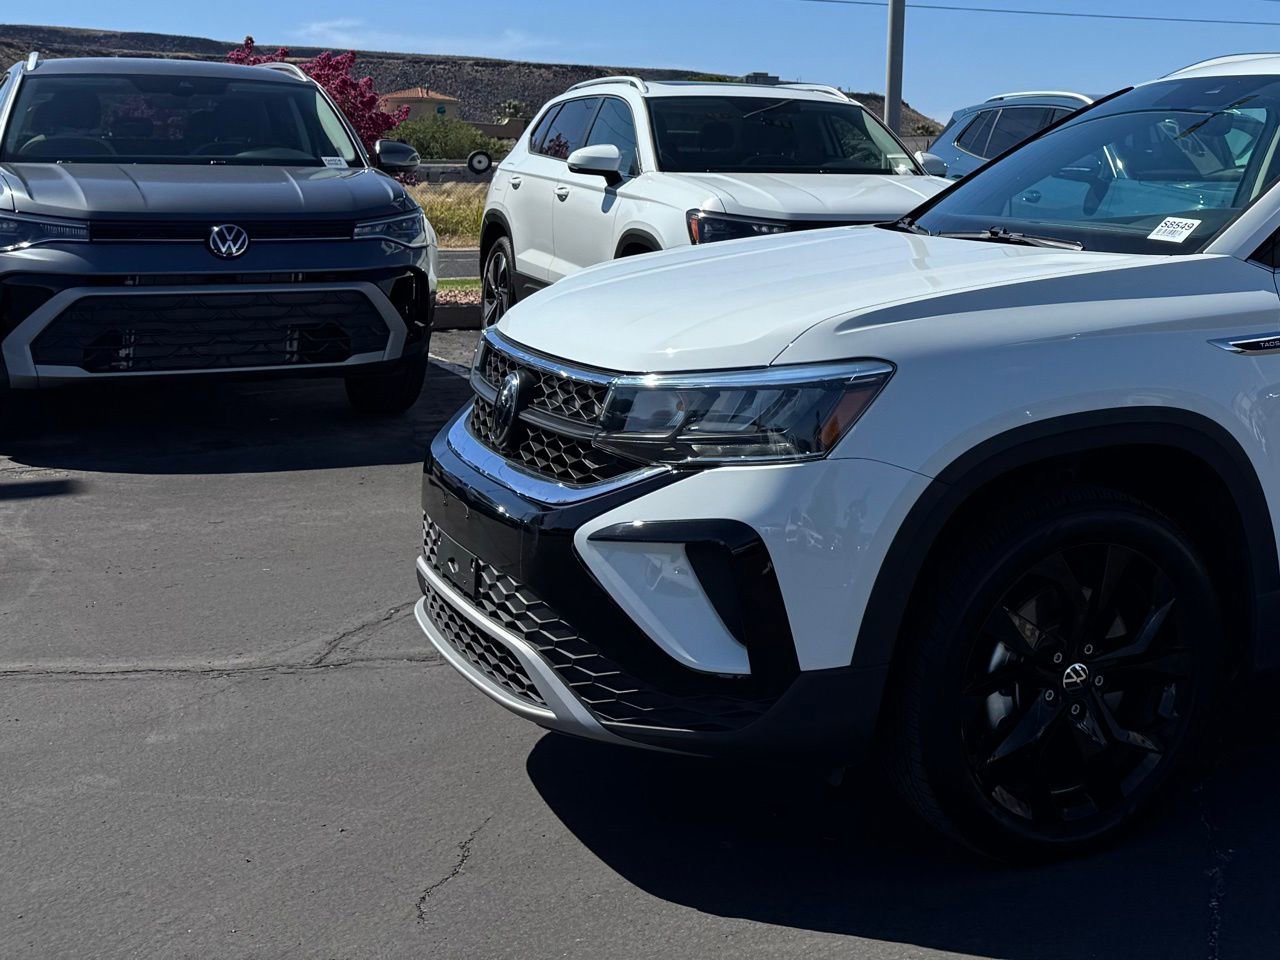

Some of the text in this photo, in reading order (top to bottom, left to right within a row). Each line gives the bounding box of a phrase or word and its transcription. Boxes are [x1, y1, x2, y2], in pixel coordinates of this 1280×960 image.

[1161, 220, 1195, 231] S8549
[211, 225, 248, 254] VW
[1260, 340, 1280, 348] TAOS
